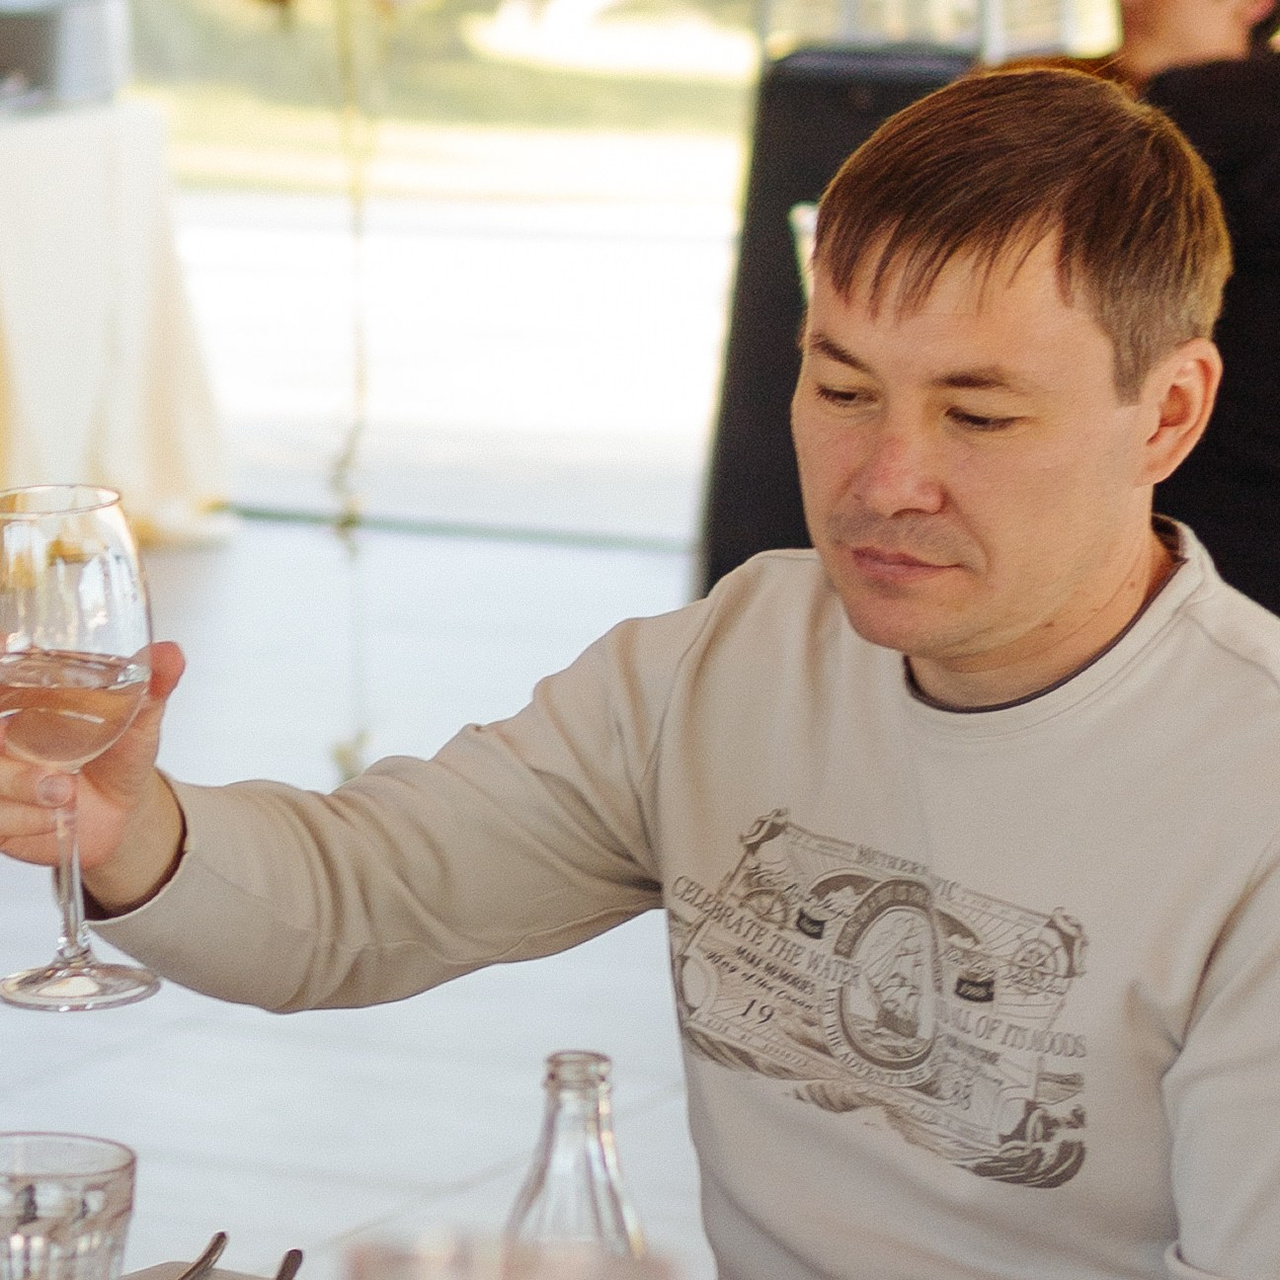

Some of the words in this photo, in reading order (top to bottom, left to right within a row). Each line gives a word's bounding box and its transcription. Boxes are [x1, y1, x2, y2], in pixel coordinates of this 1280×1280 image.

[672, 875, 768, 946] CELEBRATE
[769, 933, 807, 967] THE
[975, 1015, 1003, 1040] OF
[741, 999, 775, 1024] 19
